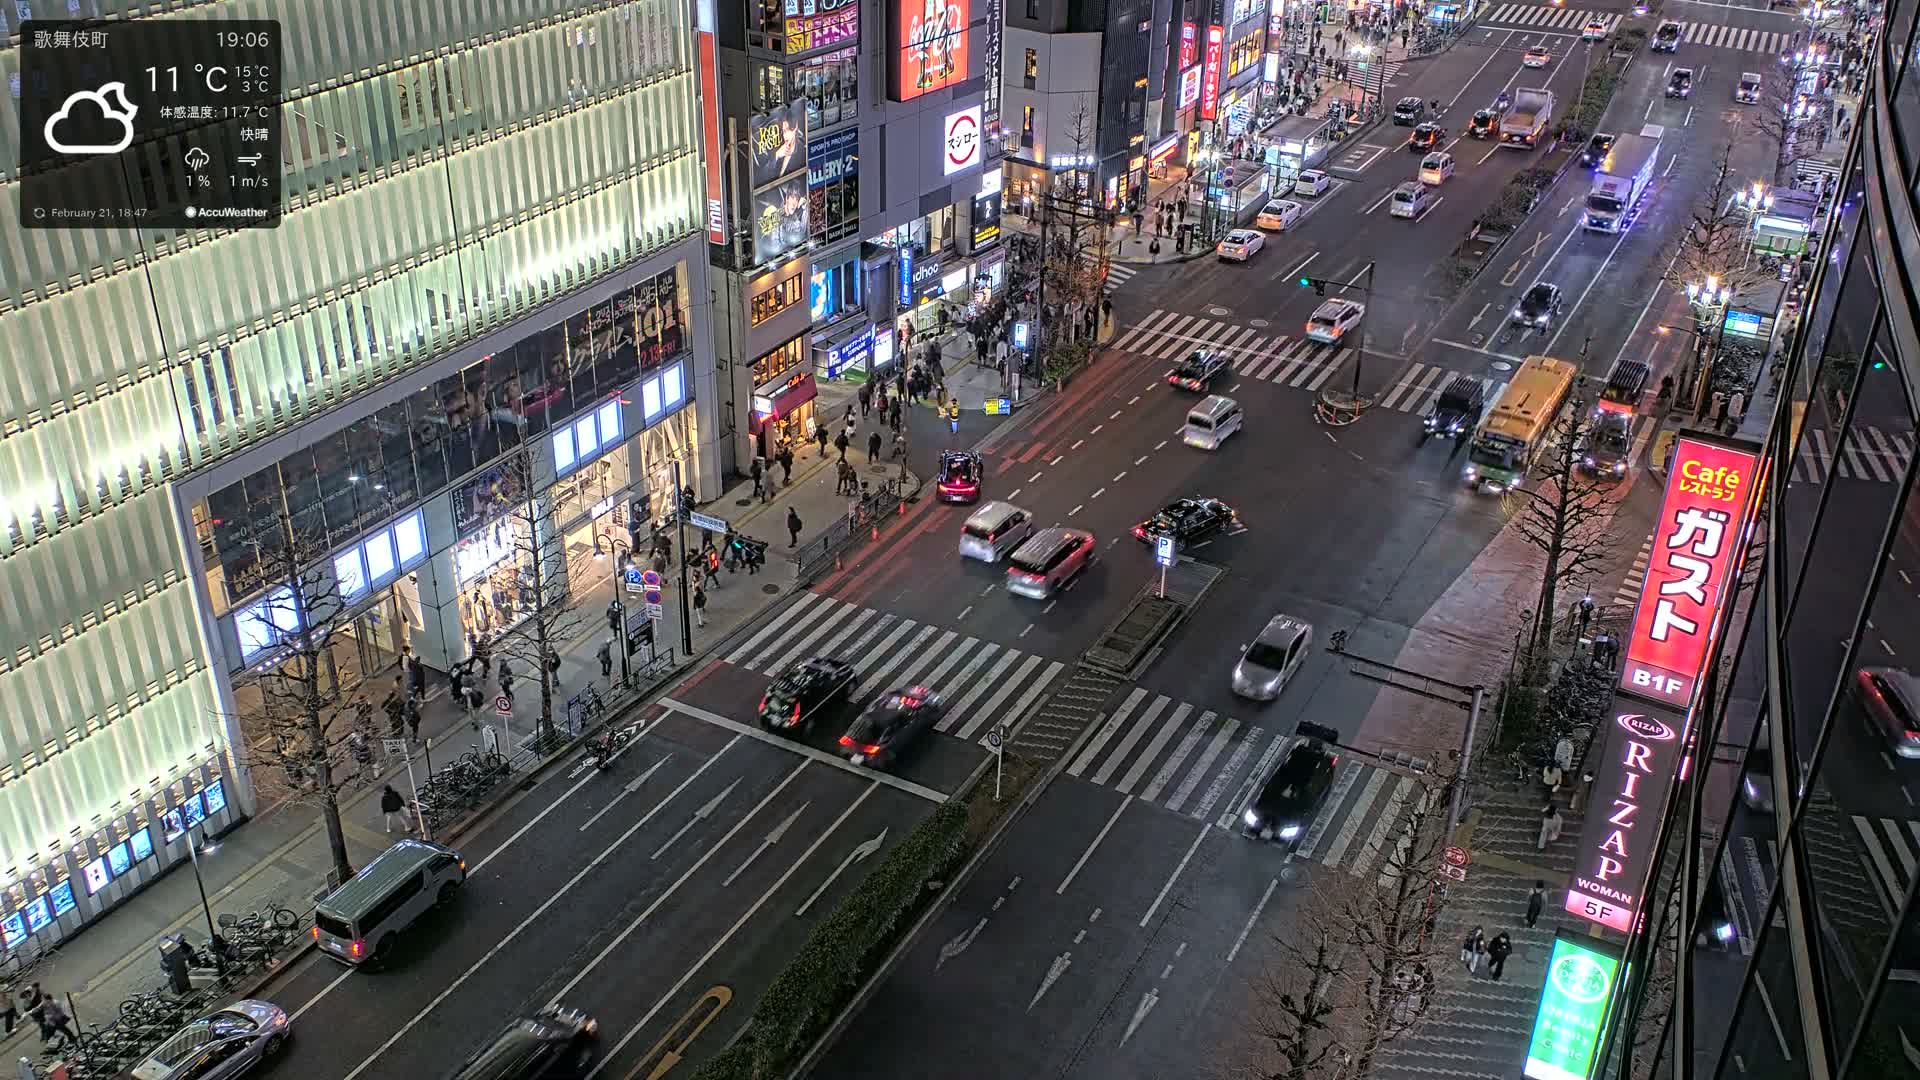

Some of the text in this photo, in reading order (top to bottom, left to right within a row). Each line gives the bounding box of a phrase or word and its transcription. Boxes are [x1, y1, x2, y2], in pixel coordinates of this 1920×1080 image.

[1204, 45, 1219, 110] バーガーキング
[810, 140, 830, 153] SPORTS
[947, 132, 978, 150] スシロー
[709, 198, 722, 232] MUJI
[830, 350, 838, 367] P
[1681, 459, 1740, 489] Café
[1679, 478, 1736, 502] レストラン
[1651, 507, 1729, 641] ガスト
[1632, 668, 1683, 695] B1F
[1630, 719, 1662, 734] RIZAP
[1595, 740, 1653, 881] RIZAP
[1577, 877, 1632, 905] WOMAN
[1585, 901, 1613, 919] 5F
